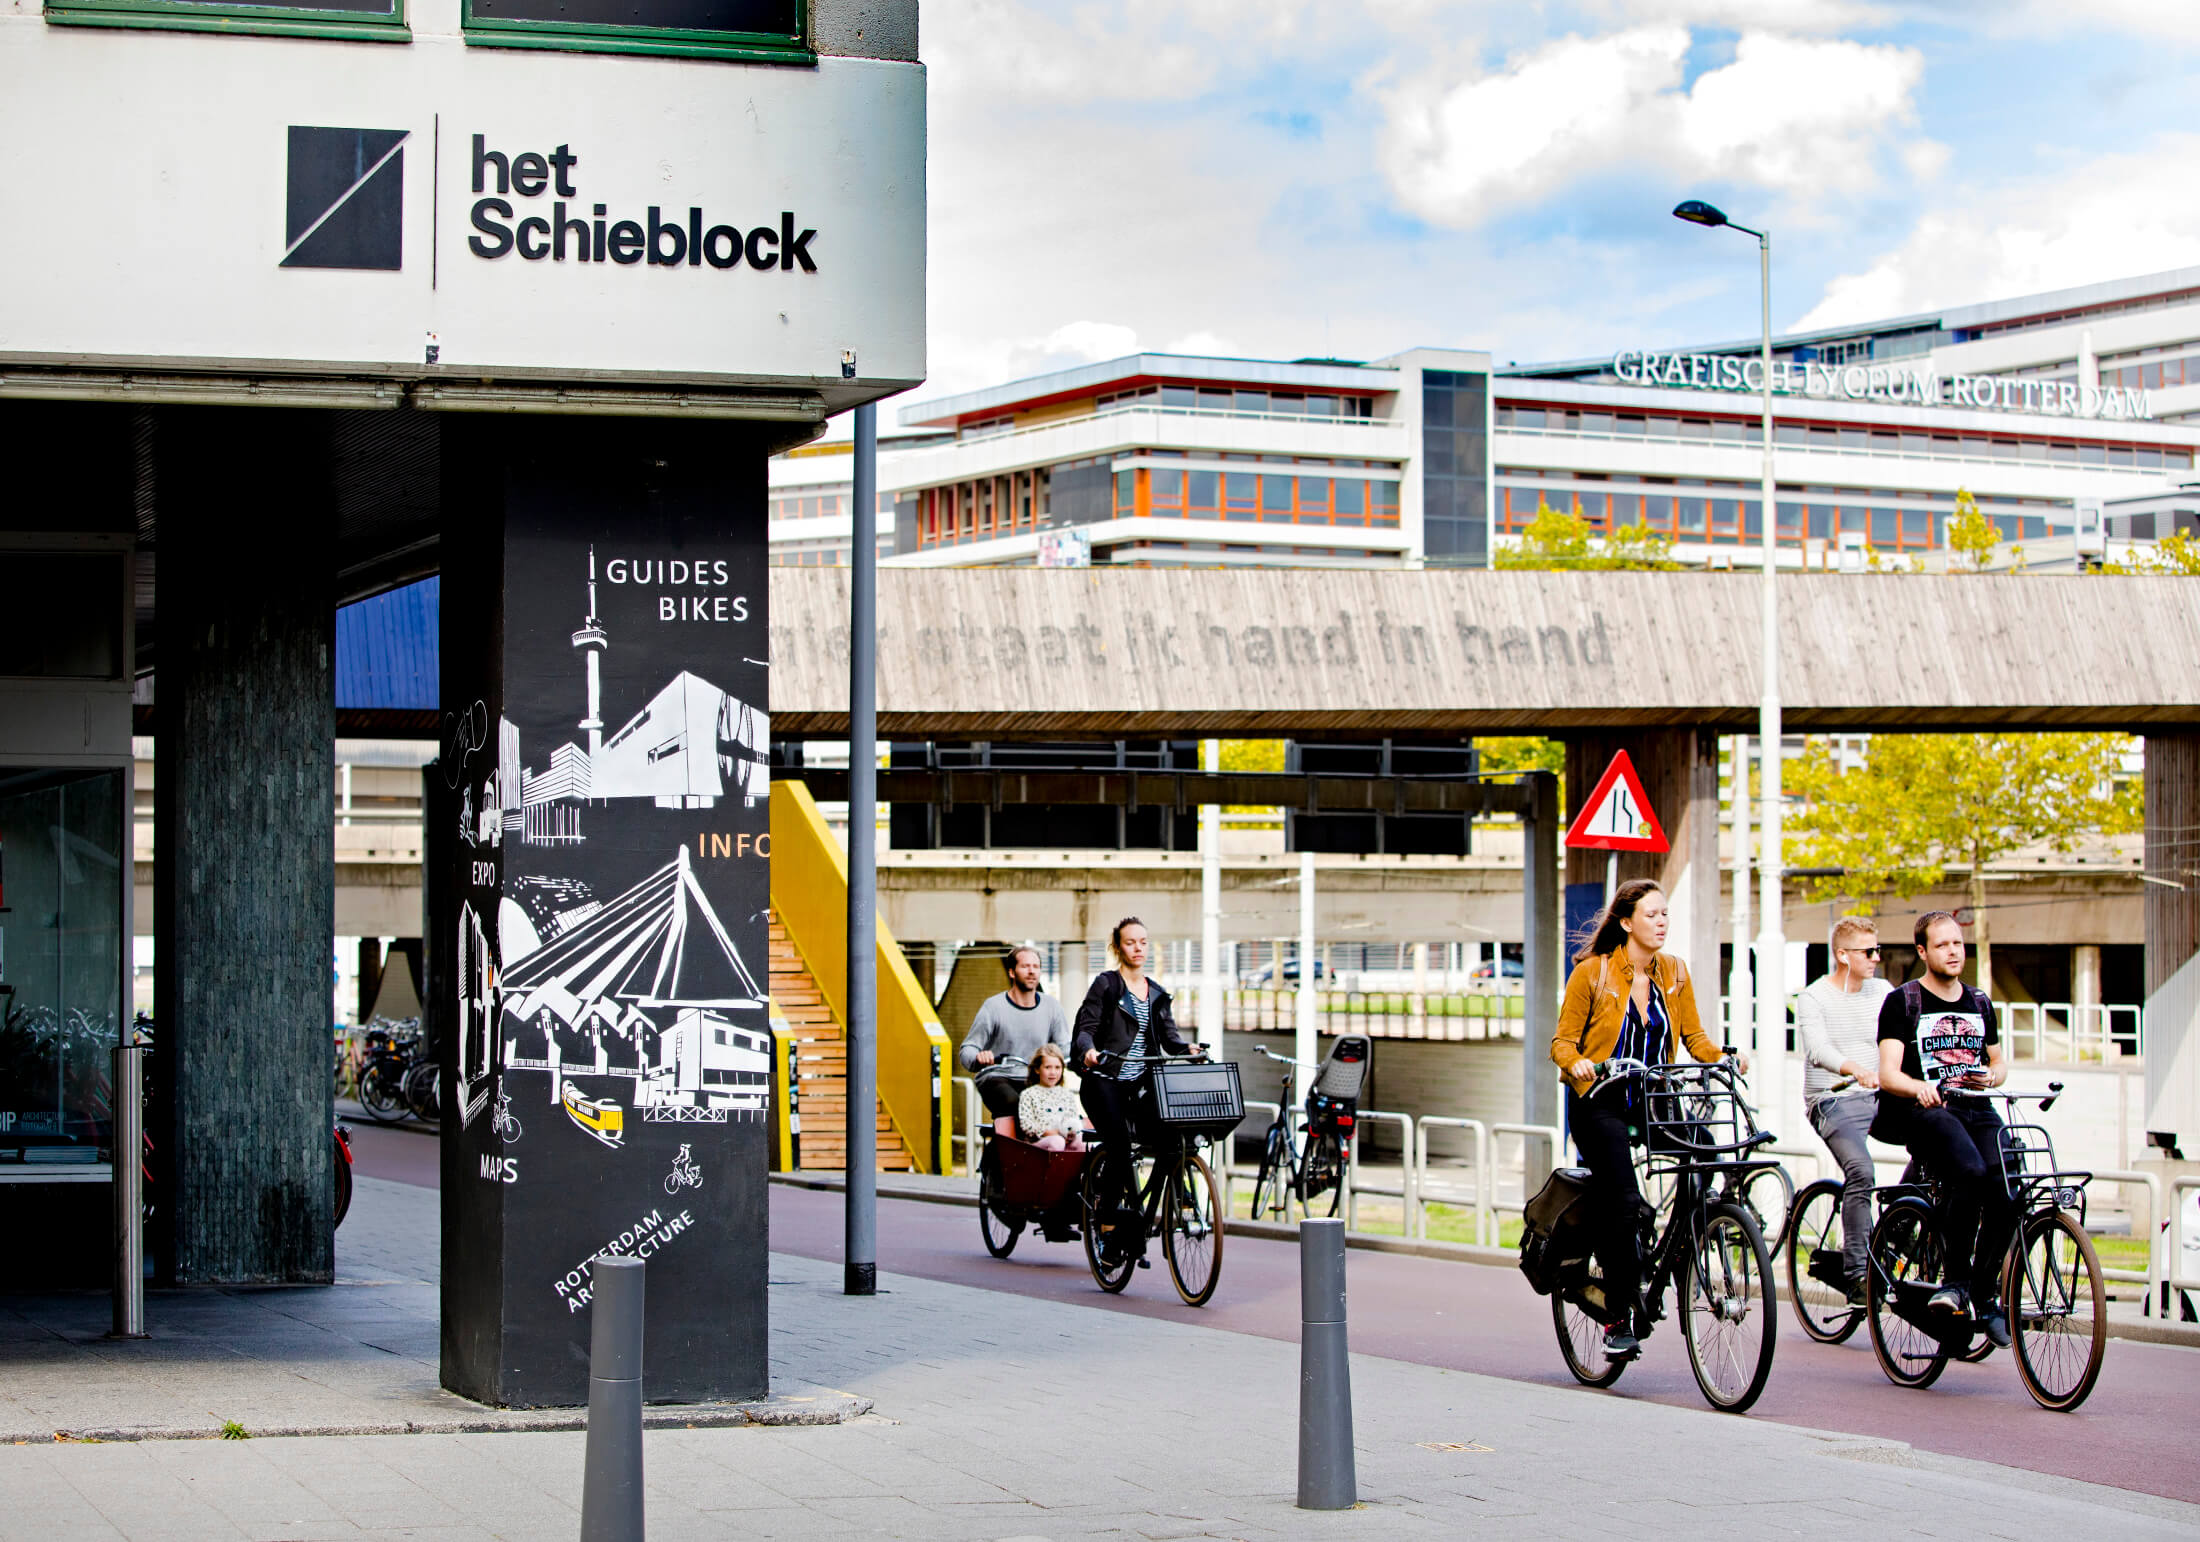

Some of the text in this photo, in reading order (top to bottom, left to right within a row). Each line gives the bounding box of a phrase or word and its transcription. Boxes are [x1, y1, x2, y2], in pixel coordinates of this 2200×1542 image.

[471, 133, 578, 198] het
[468, 197, 818, 273] Schieblock
[1613, 350, 2153, 420] GRAFISCH LYCEUM ROTTERDAM
[606, 558, 730, 586] GUIDES
[658, 596, 749, 622] BIKES
[1193, 610, 1358, 667] hand
[1373, 609, 1432, 665] in
[1453, 610, 1614, 667] hand
[699, 833, 770, 858] INFO
[472, 861, 496, 887] EXPO
[481, 1153, 519, 1183] MAPS
